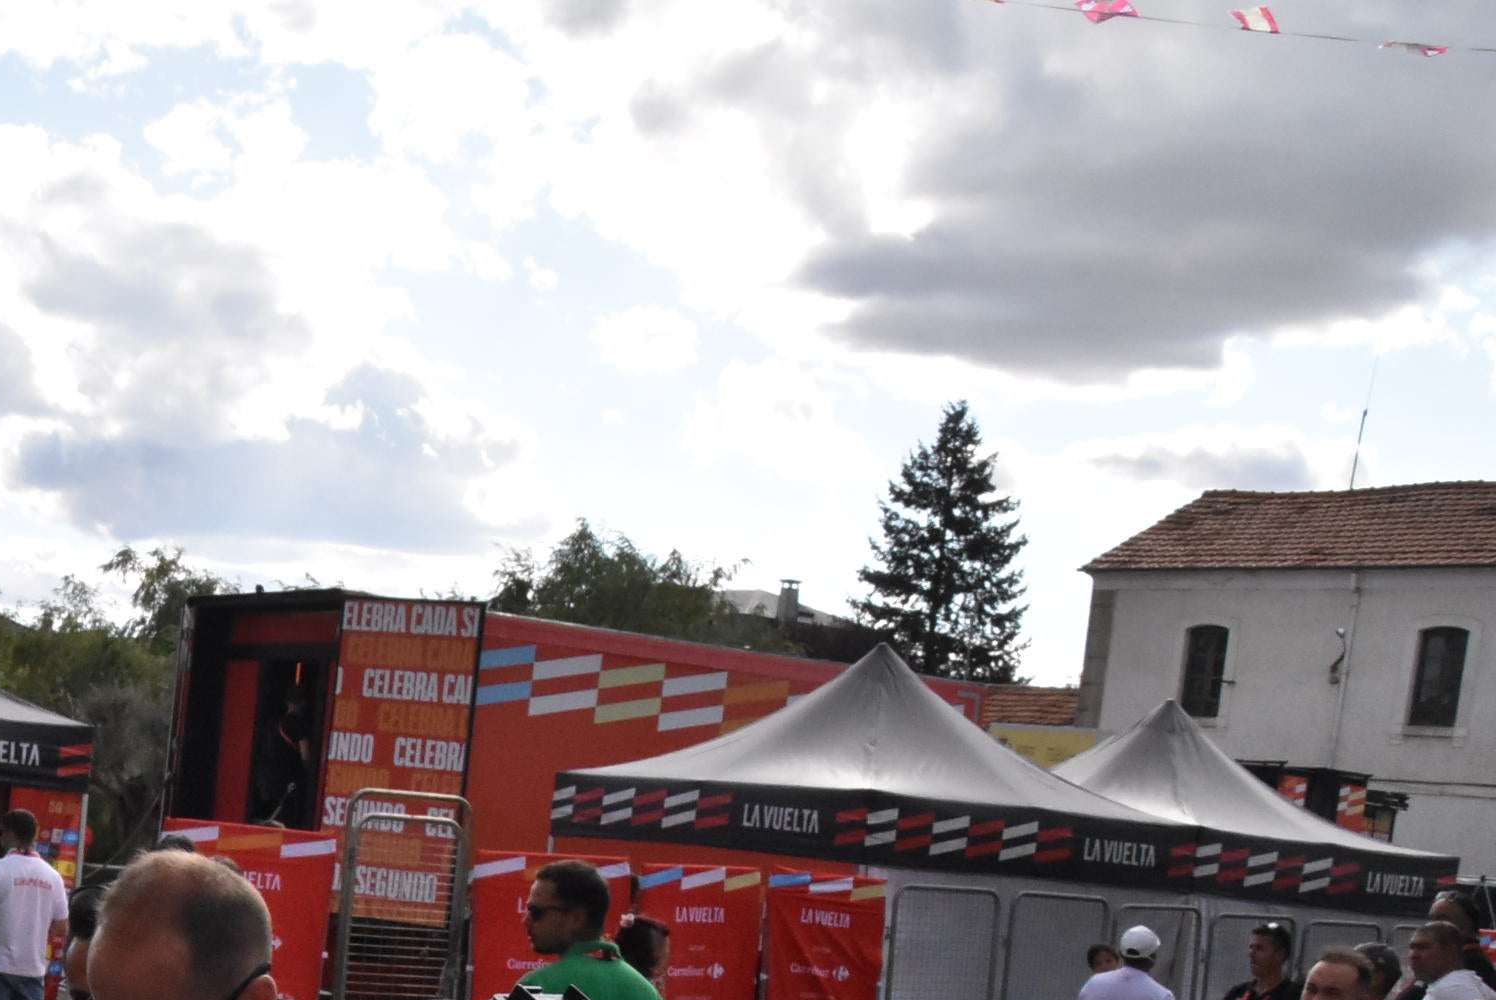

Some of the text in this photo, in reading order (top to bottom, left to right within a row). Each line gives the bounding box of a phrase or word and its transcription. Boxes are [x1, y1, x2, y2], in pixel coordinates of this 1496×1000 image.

[410, 606, 457, 636] CADA
[363, 668, 438, 702] CELEBRA
[742, 804, 820, 834] LA VUELTA
[1083, 837, 1156, 868] LA VUELTA
[243, 872, 281, 891] ELTA
[354, 865, 437, 903] SEGUNDO
[1366, 871, 1425, 897] LA VUELTA
[676, 906, 725, 924] LA VUELTA
[801, 908, 850, 929] LA VUELTA
